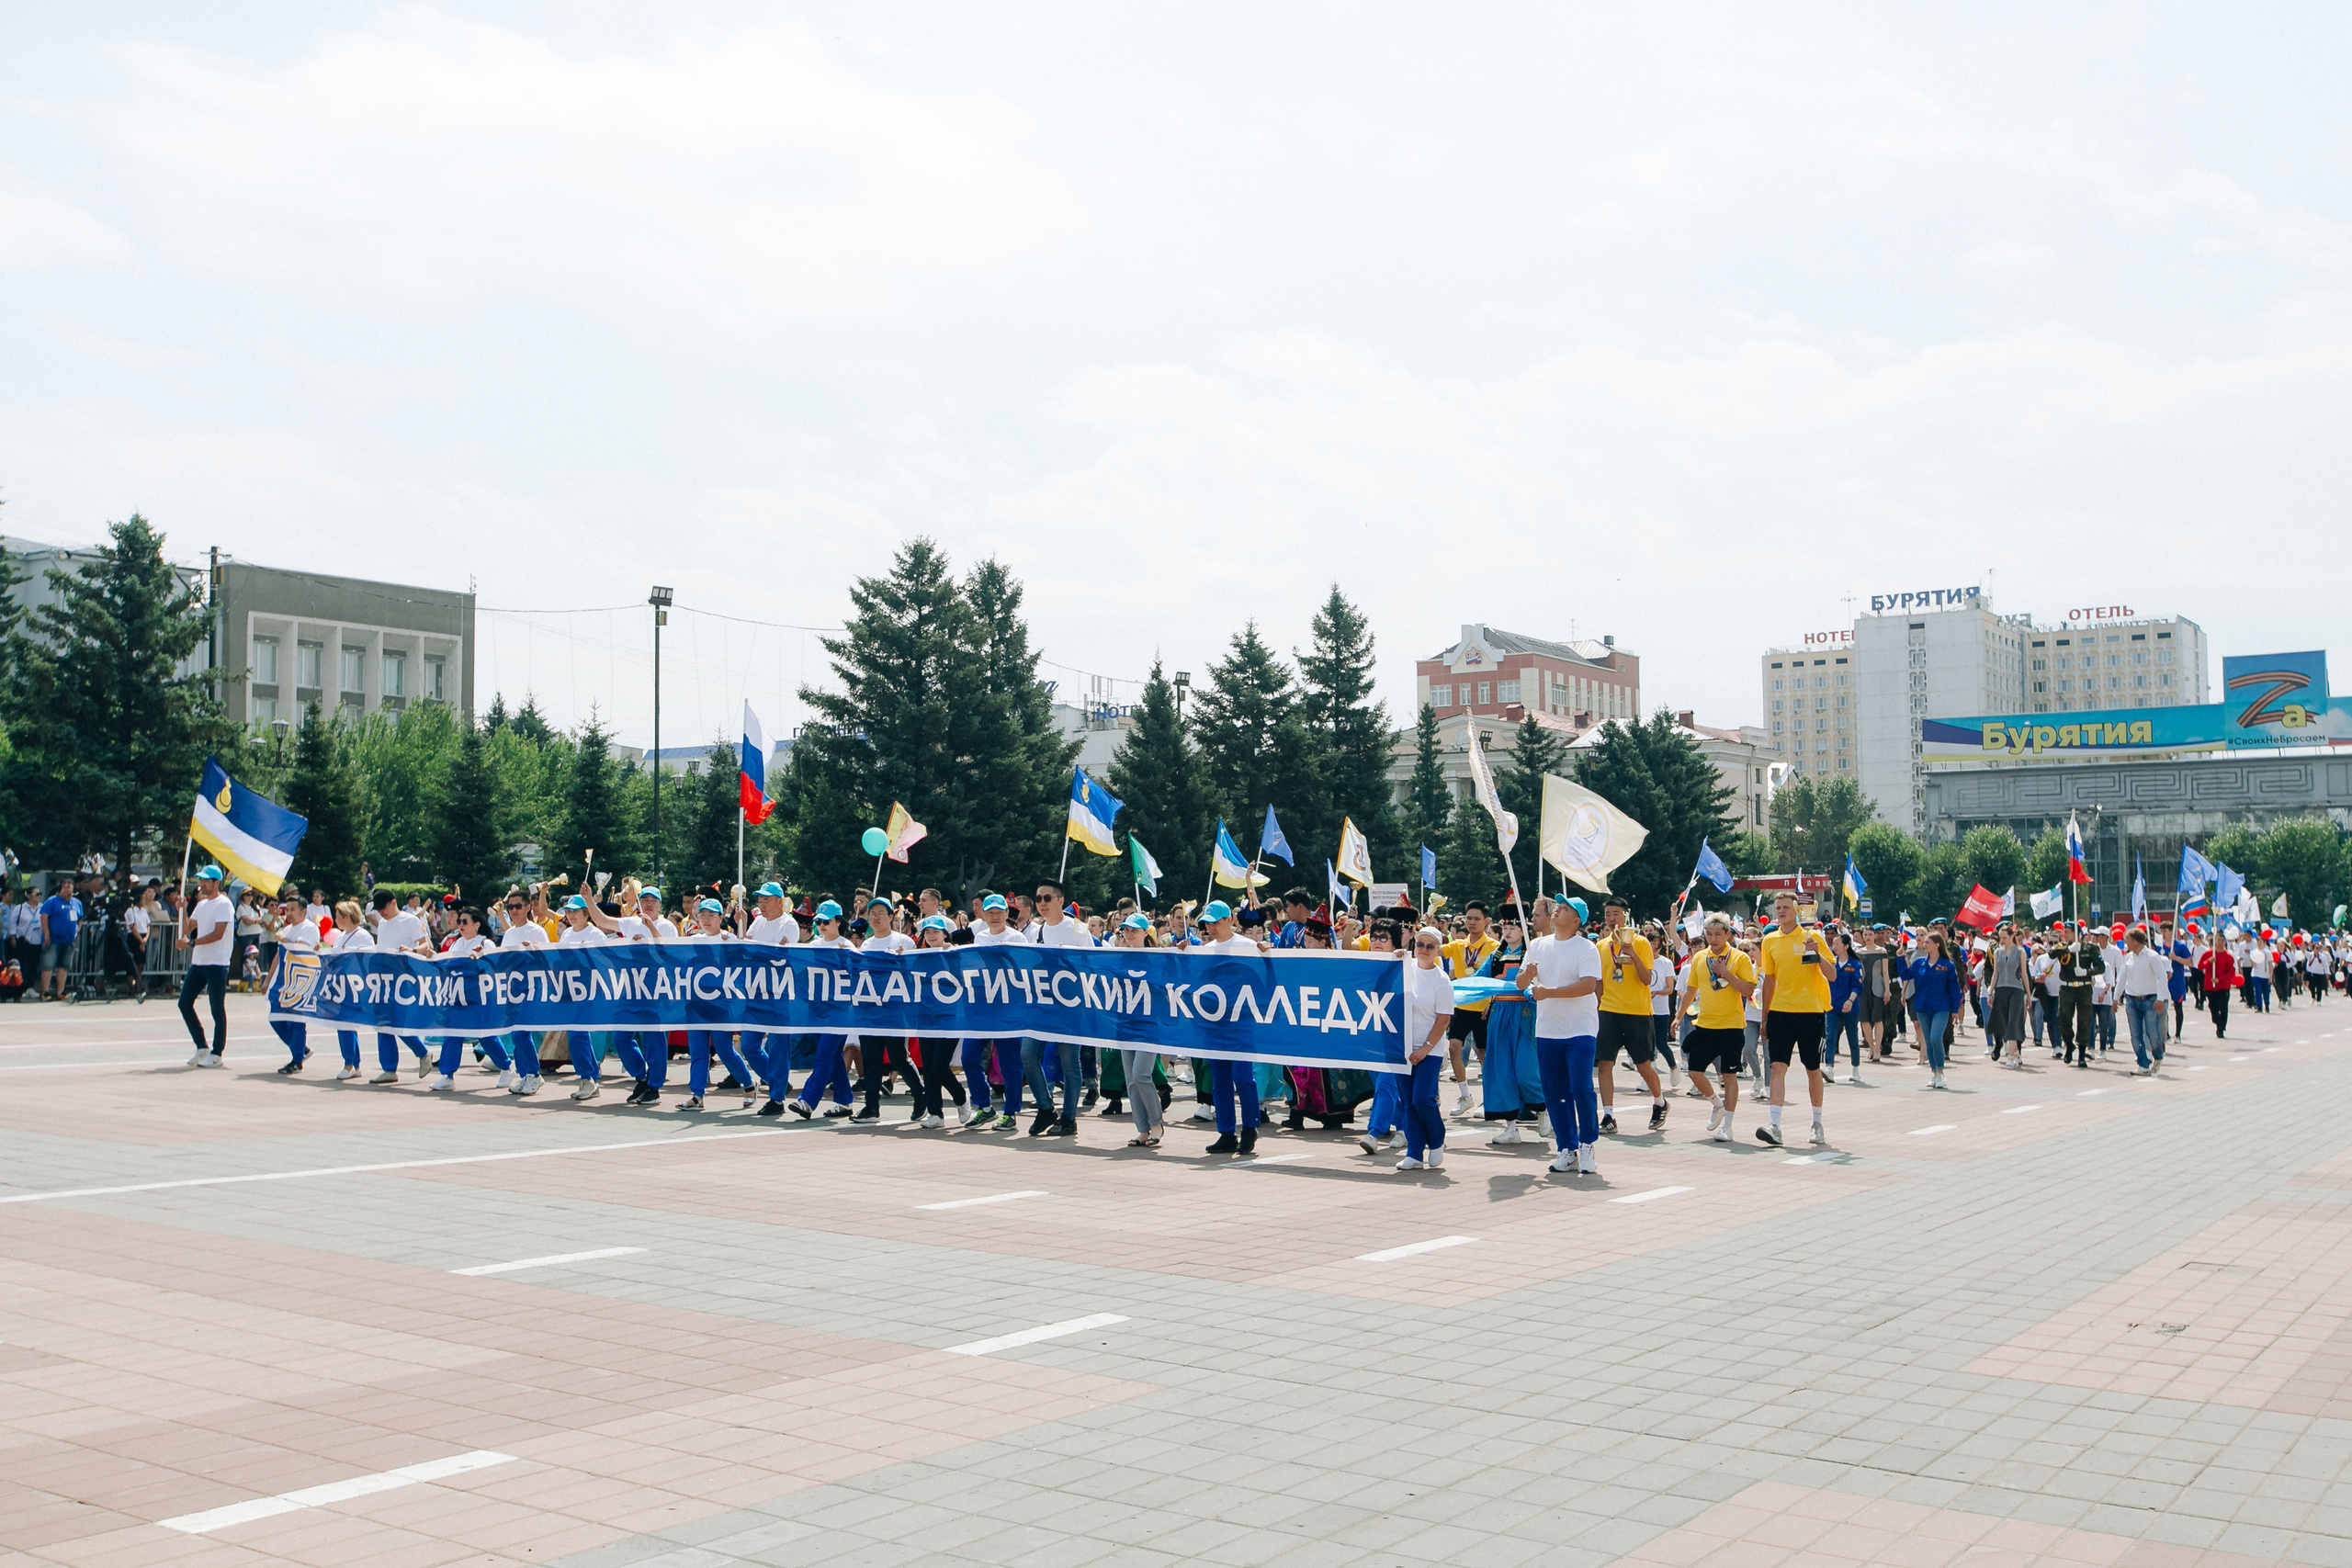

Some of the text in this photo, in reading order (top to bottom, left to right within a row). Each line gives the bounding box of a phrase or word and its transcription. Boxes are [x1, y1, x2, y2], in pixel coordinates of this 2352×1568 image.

[1871, 586, 1980, 611] БУРЯТИЯ
[2068, 605, 2134, 621] ОТЕЛЬ
[1804, 630, 1854, 644] HOTE
[1982, 720, 2153, 754] Бурятия
[2227, 734, 2326, 746] #СвоихНеБросаем
[319, 959, 1398, 1035] БУРЯТСКИЙ РЕСПУБЛИКАНСКИЙ ПЕДАГОГИЧЕСКИЙ КОЛЛЕДЖ
